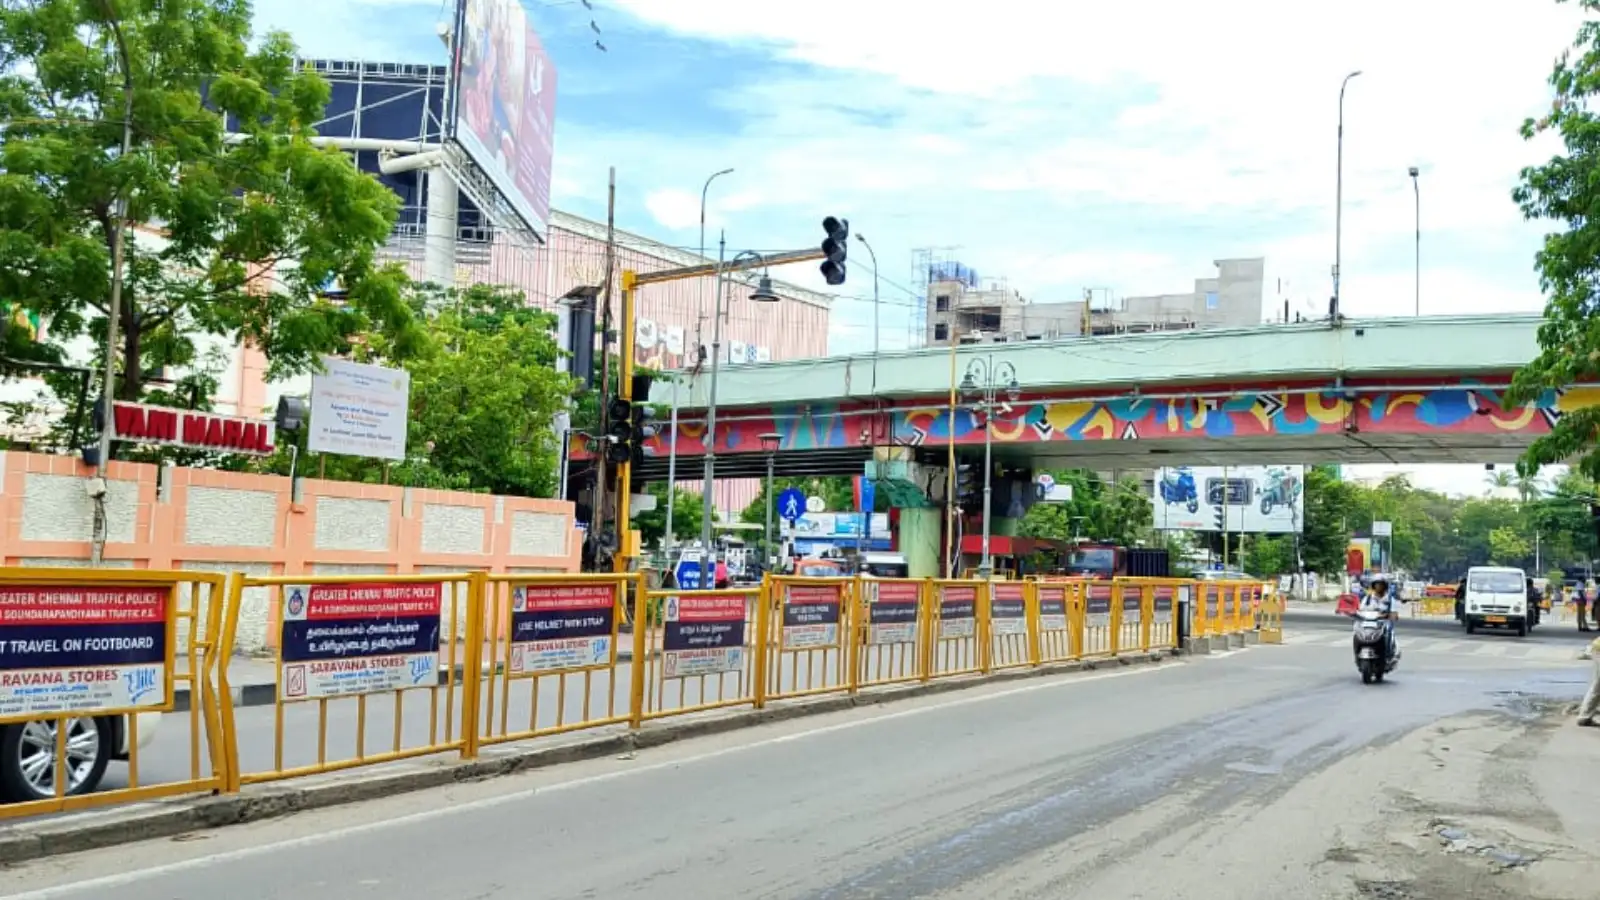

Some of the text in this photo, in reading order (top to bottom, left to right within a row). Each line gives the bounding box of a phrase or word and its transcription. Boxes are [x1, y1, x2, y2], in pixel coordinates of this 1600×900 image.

[113, 404, 275, 453] VANI MAHAL
[0, 592, 157, 605] EATER CHENNAI TRAFFIC POLICE
[313, 587, 435, 601] GREATER CHENNAI TRAFFIC POLICE
[108, 609, 140, 619] TRAFFIC
[534, 619, 563, 630] HELMET
[10, 639, 60, 654] TRAVEL
[62, 638, 82, 652] ON
[84, 636, 154, 651] FOOTBOARD
[310, 657, 405, 674] SARAVANA STORES
[68, 669, 119, 684] STORES
